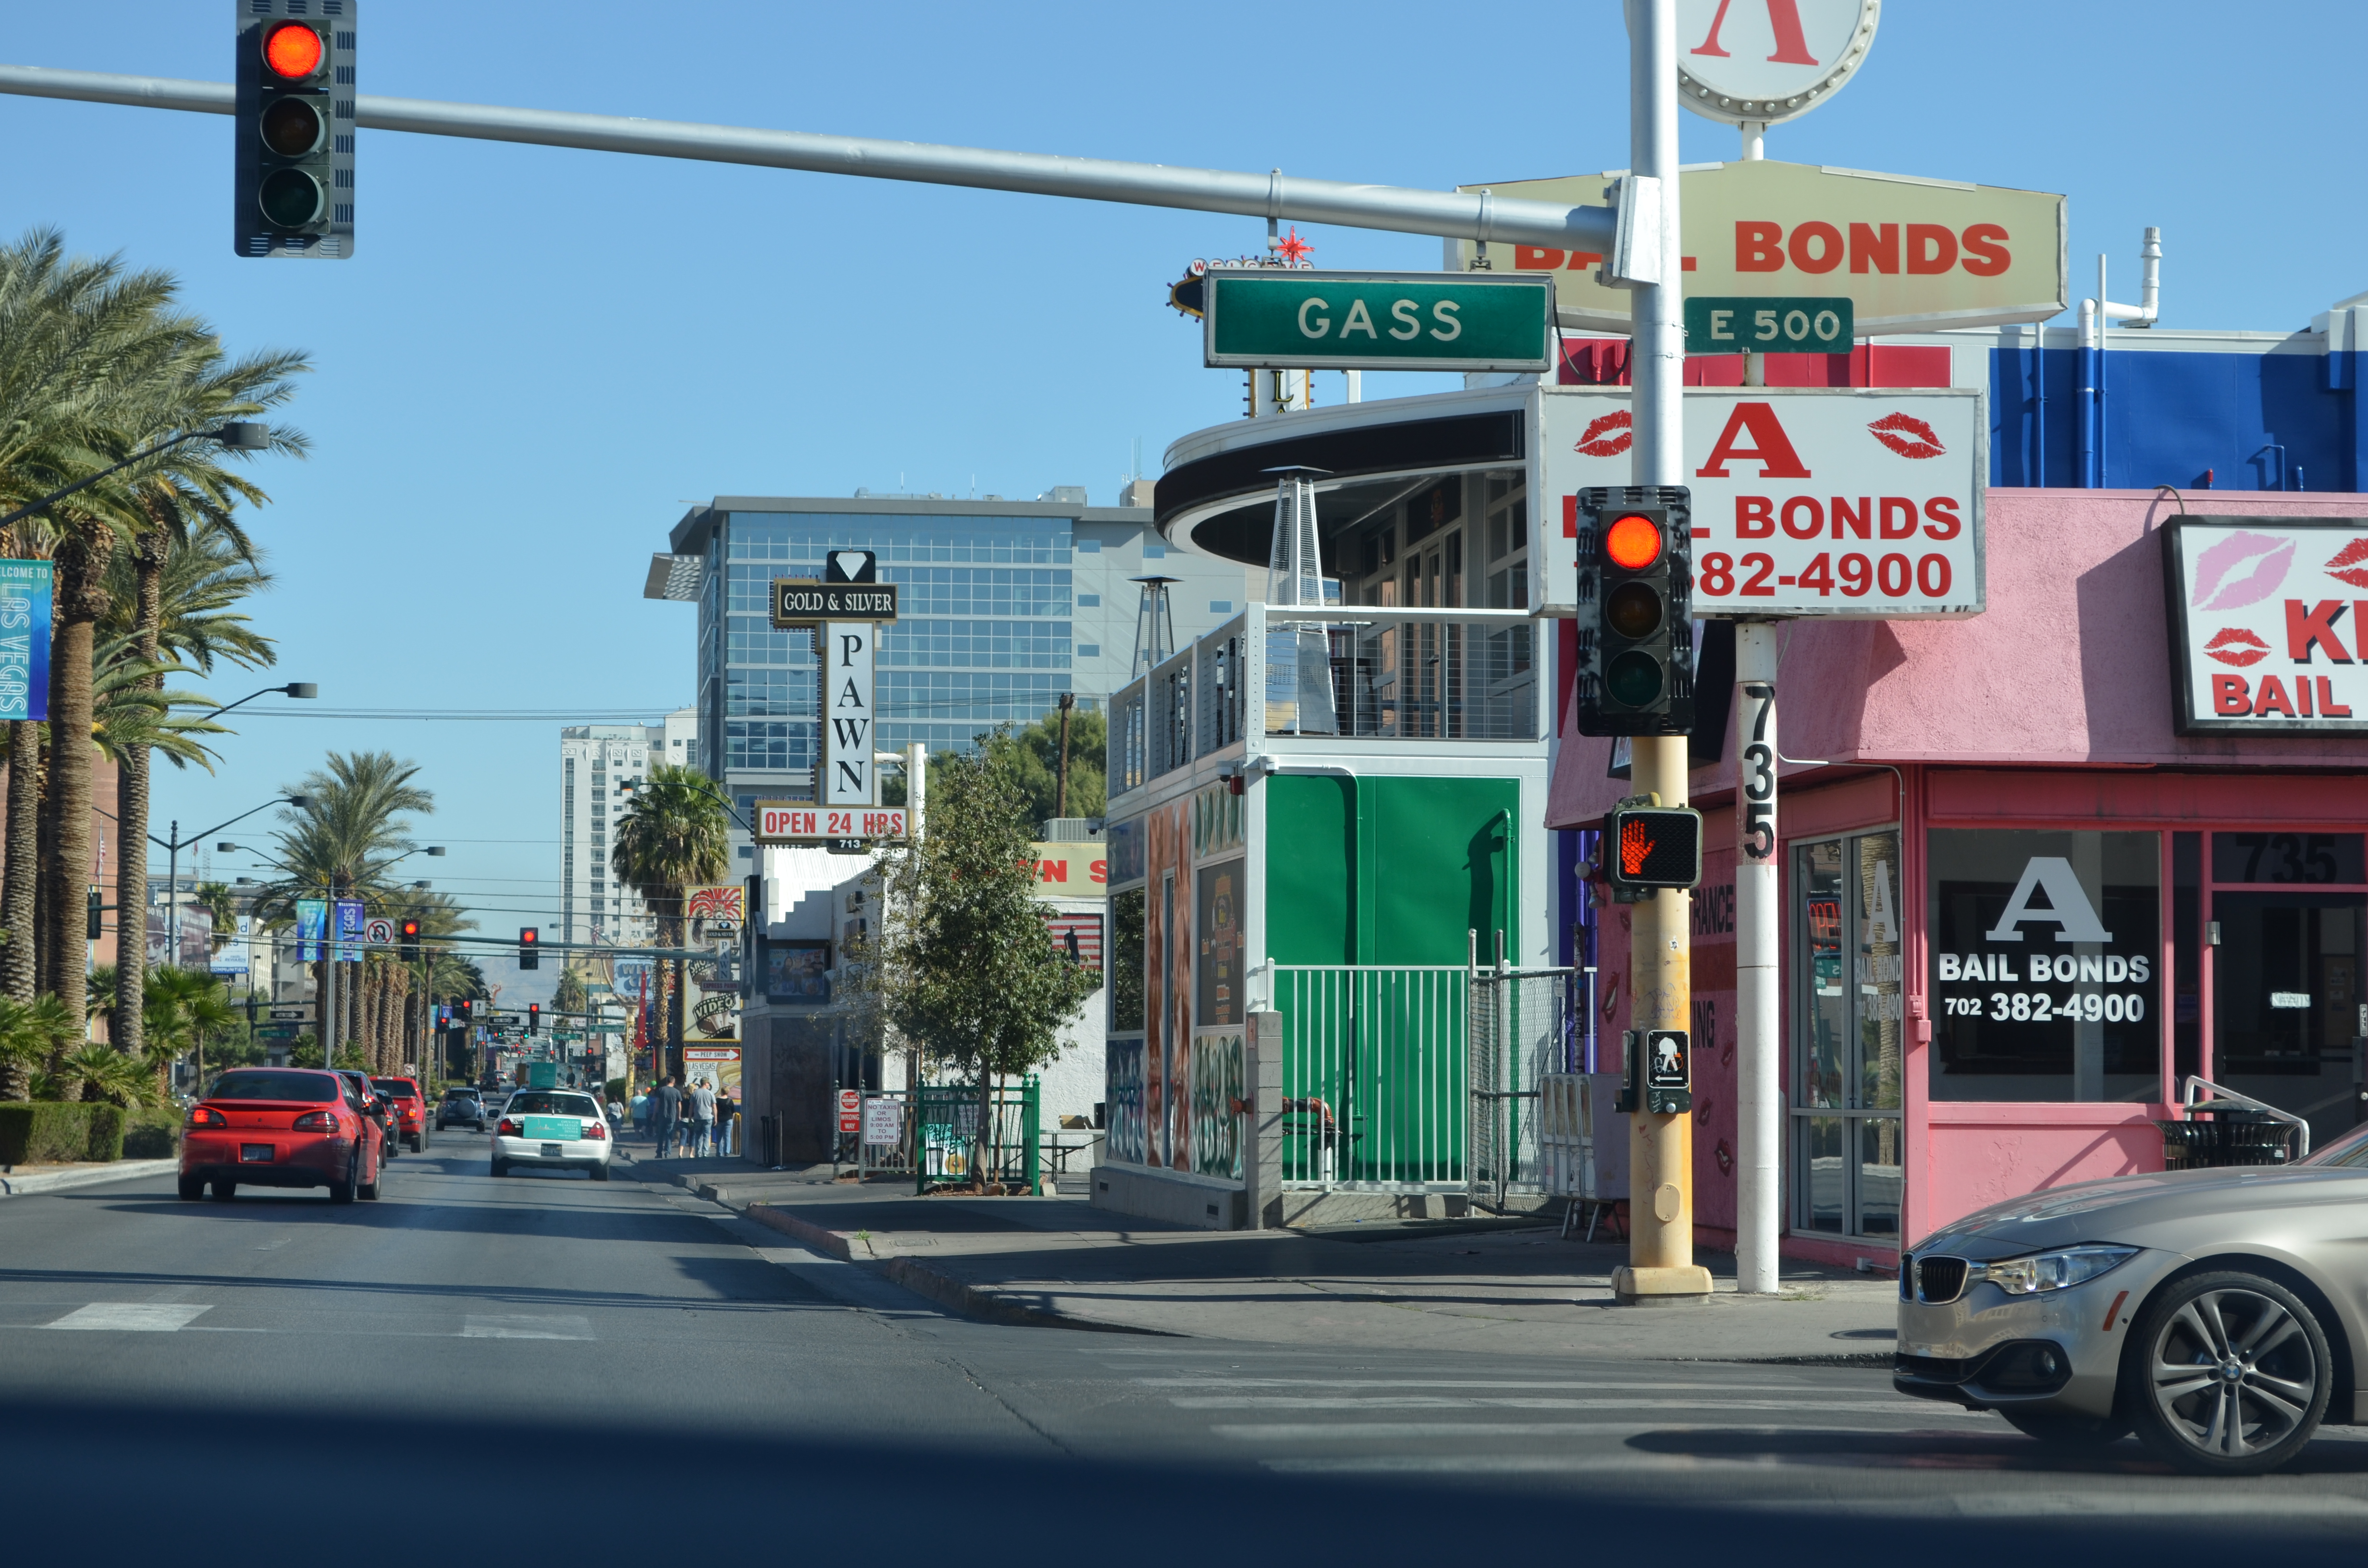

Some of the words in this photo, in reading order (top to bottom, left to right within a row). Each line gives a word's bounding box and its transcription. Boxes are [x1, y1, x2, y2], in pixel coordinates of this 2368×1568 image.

[1735, 220, 2012, 277] BONDS
[1298, 297, 1462, 342] GASS
[1711, 310, 1733, 340] E
[1754, 309, 1840, 341] 500
[1696, 403, 1811, 478] A
[1736, 495, 1961, 540] BONDS
[0, 567, 33, 578] LCOME
[37, 568, 48, 578] TO
[1692, 552, 1952, 597] 82-4900
[1, 583, 31, 628] LAS
[784, 593, 823, 611] GOLD
[828, 593, 840, 611] &
[845, 593, 893, 611] SILVER
[0, 635, 29, 712] VEGAS
[832, 635, 870, 793] PAWN
[2212, 674, 2353, 718] BAIL
[1744, 686, 1775, 859] 735
[765, 811, 816, 834] OPEN
[827, 813, 851, 834] 24
[864, 812, 902, 834] HRS
[839, 839, 861, 849] 713
[2236, 833, 2337, 883] 735
[1866, 860, 1898, 943] A
[1986, 857, 2112, 943] A
[344, 908, 356, 940] VEGAS
[720, 942, 728, 979] PAWN
[1855, 957, 1874, 983] BAIL
[1939, 954, 2018, 981] BAIL
[2030, 955, 2149, 983] BONDS
[696, 997, 733, 1017] VIDEO
[1856, 1001, 1866, 1017] 702
[1945, 998, 1982, 1015] 702
[1990, 993, 2145, 1022] 382-4900
[698, 1062, 715, 1070] VEGAS
